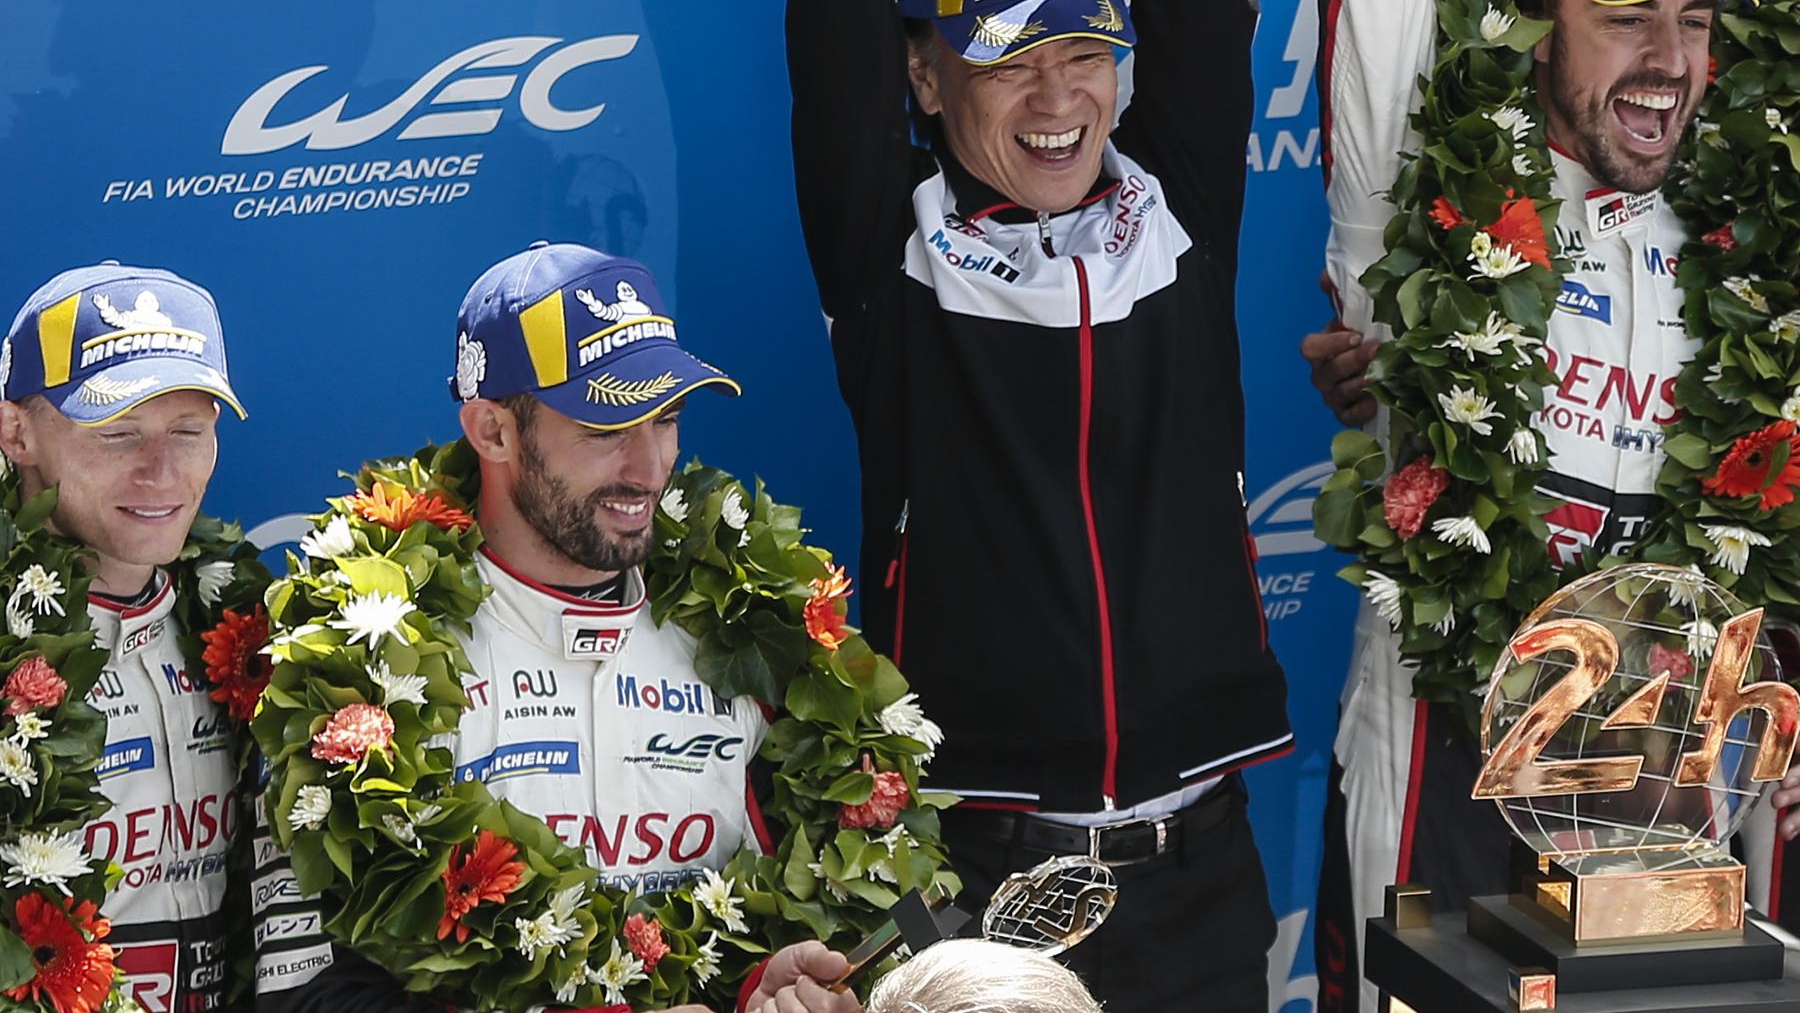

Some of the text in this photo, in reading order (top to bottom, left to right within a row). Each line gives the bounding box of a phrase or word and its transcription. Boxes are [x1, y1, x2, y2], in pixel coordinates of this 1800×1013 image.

[220, 34, 640, 156] WEC
[102, 151, 483, 204] FIA WORLD ENDURANCE
[232, 182, 471, 221] CHAMPIONSHIP
[1104, 175, 1146, 254] DENSO
[1600, 208, 1628, 230] GR
[928, 229, 994, 271] Mobil
[1115, 213, 1142, 259] TOYOTA
[1581, 261, 1606, 272] AW
[80, 332, 205, 369] MICHELIN
[578, 322, 677, 367] MICHELIN
[573, 636, 617, 653] GR
[504, 705, 576, 720] AISIN AW
[616, 673, 705, 714] Mobil
[96, 747, 143, 772] HELIN
[647, 733, 744, 761] WEC
[481, 751, 569, 783] MICHELIN
[84, 790, 238, 865] DENSO
[545, 812, 714, 867] ENSO
[277, 953, 332, 976] ELECTRIC
